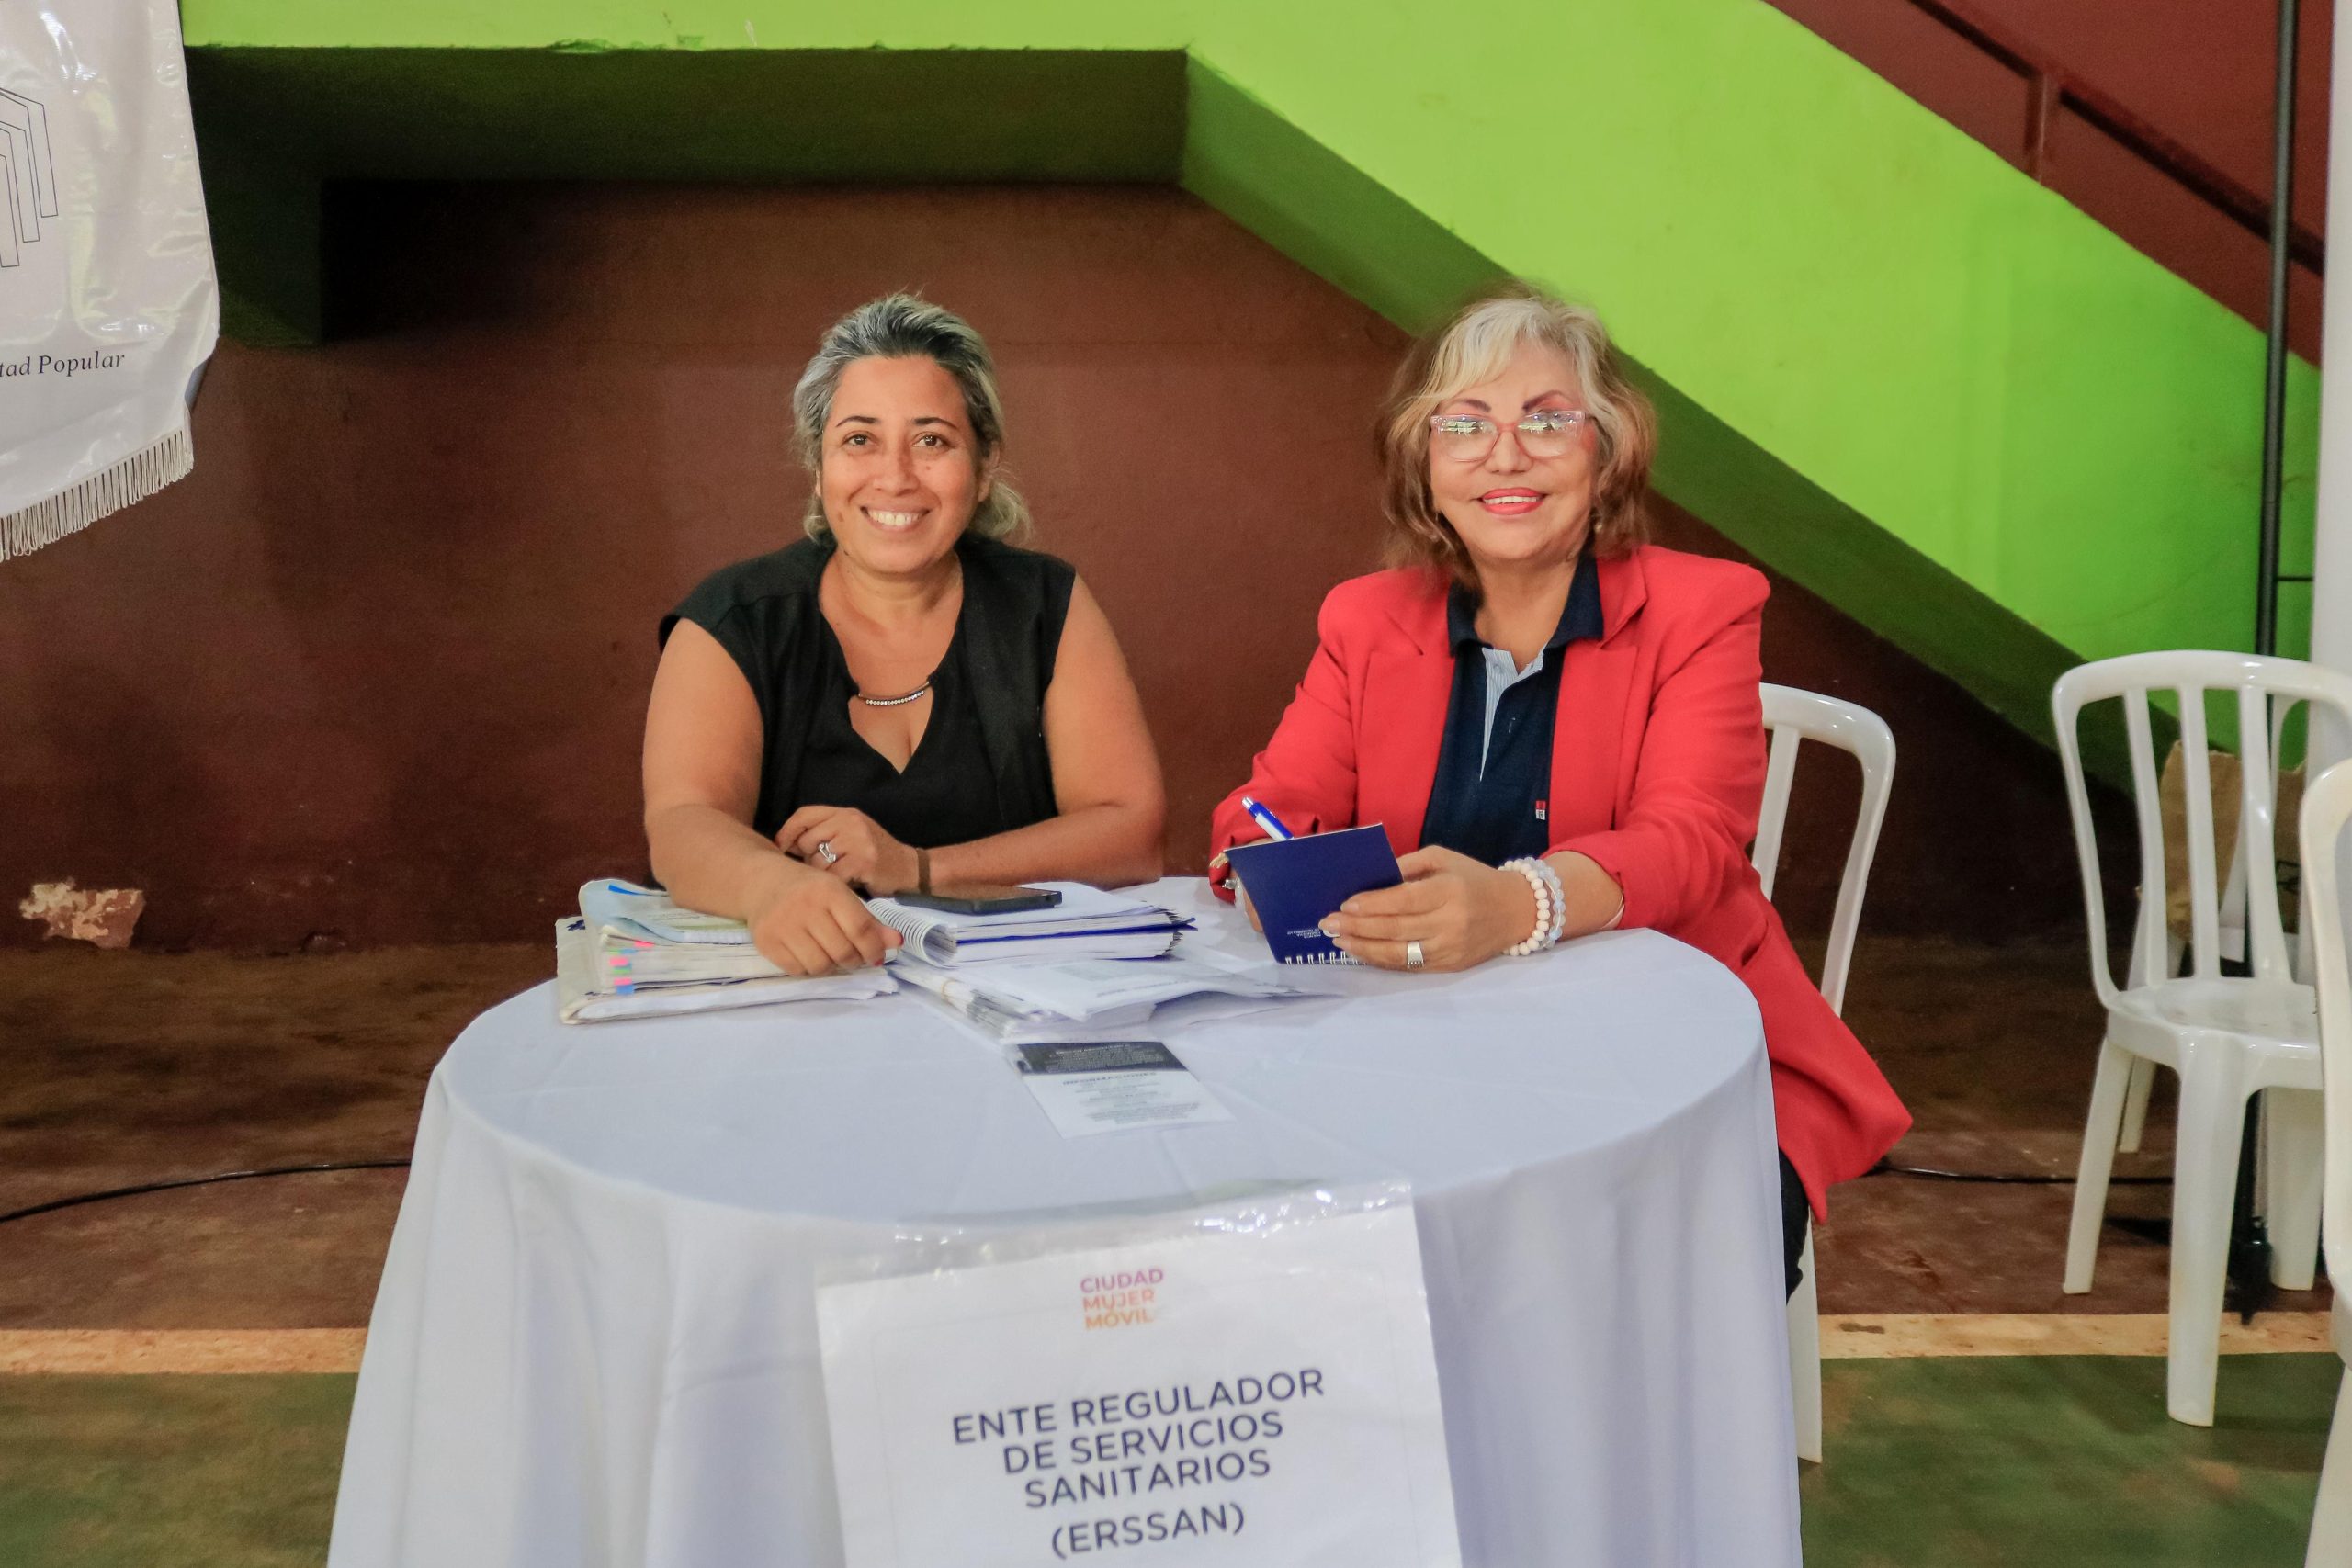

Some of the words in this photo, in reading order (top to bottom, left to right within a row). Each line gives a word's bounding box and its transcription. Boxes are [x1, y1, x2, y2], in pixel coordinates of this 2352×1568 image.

[38, 350, 125, 377] Popular
[1080, 1268, 1164, 1293] CIUDAD
[1082, 1288, 1155, 1311] MUJER
[1085, 1307, 1155, 1329] MÓVIL
[953, 1404, 1057, 1443] ENTE
[1071, 1369, 1324, 1428] REGULADOR
[1002, 1440, 1057, 1474] DE
[1070, 1411, 1283, 1465] SERVICIOS
[1024, 1449, 1271, 1508] SANITARIOS
[1051, 1502, 1245, 1560] (ERSSAN)
